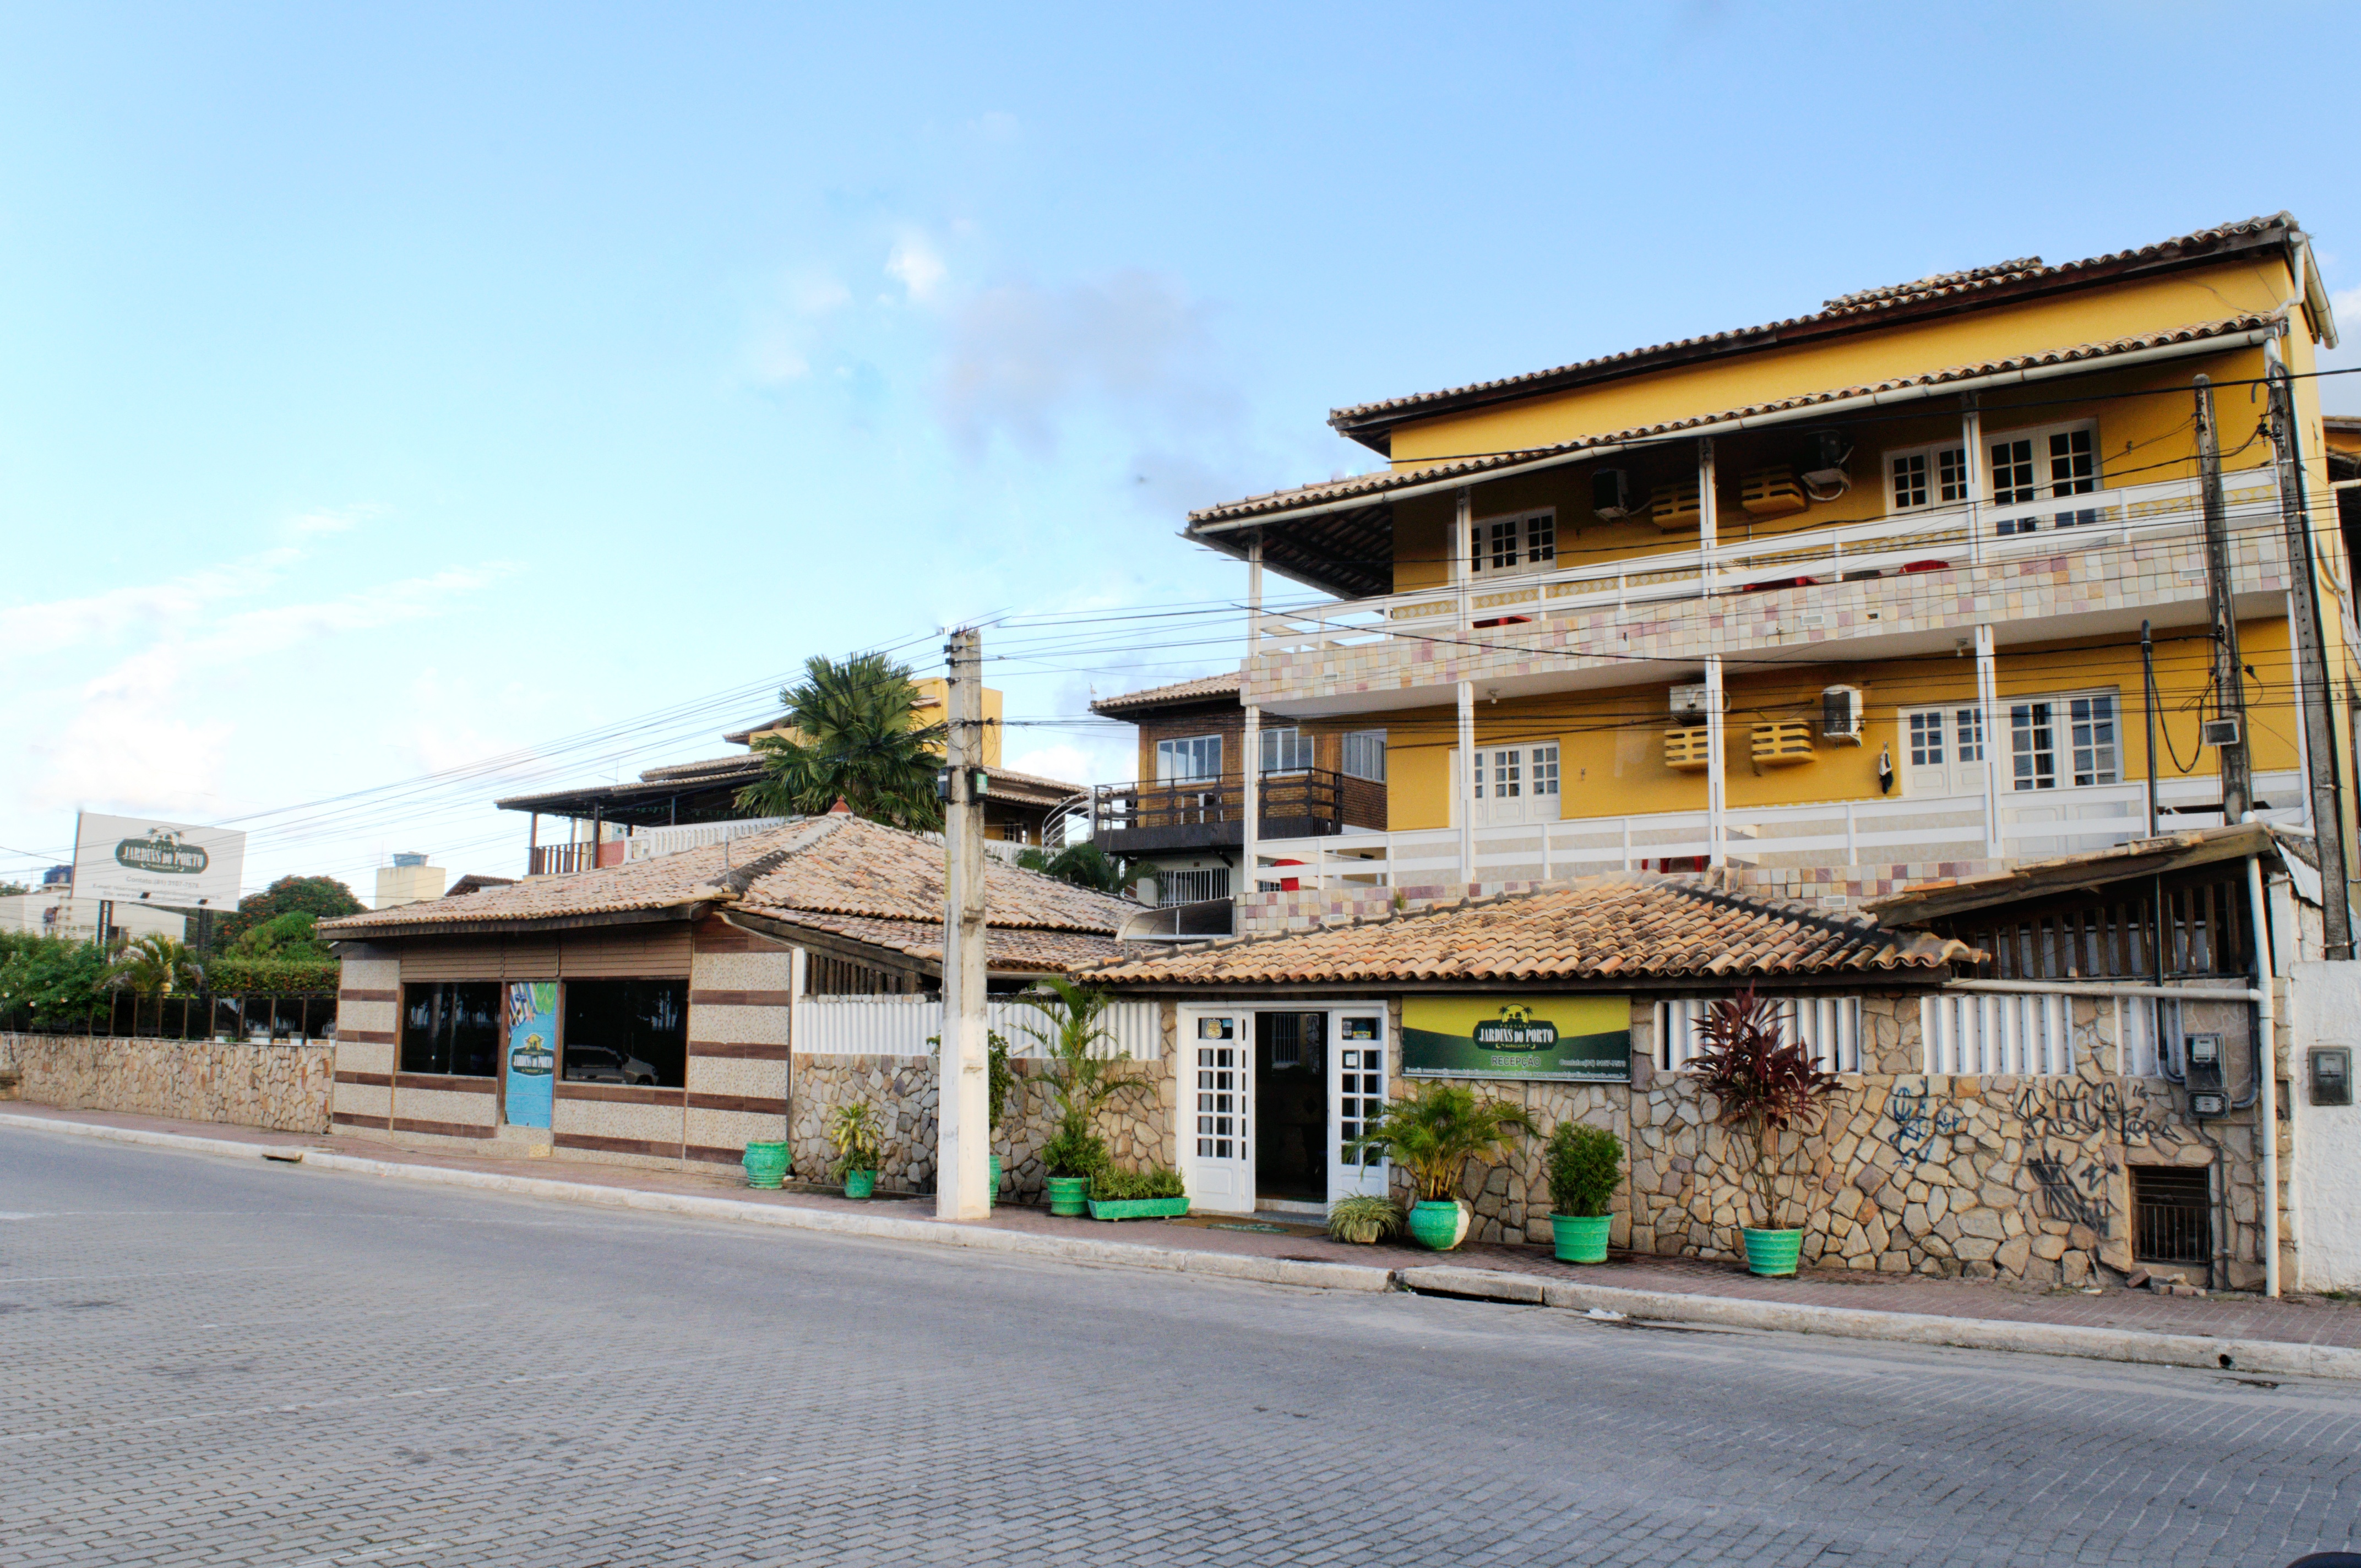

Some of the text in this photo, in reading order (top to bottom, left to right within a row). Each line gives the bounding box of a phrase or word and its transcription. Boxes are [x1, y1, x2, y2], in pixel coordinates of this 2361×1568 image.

[122, 846, 161, 862] JARDINS
[174, 852, 204, 868] PORTO
[1478, 1028, 1553, 1043] JARDINS DO PORTO
[1492, 1054, 1541, 1068] RECEPÇÃO
